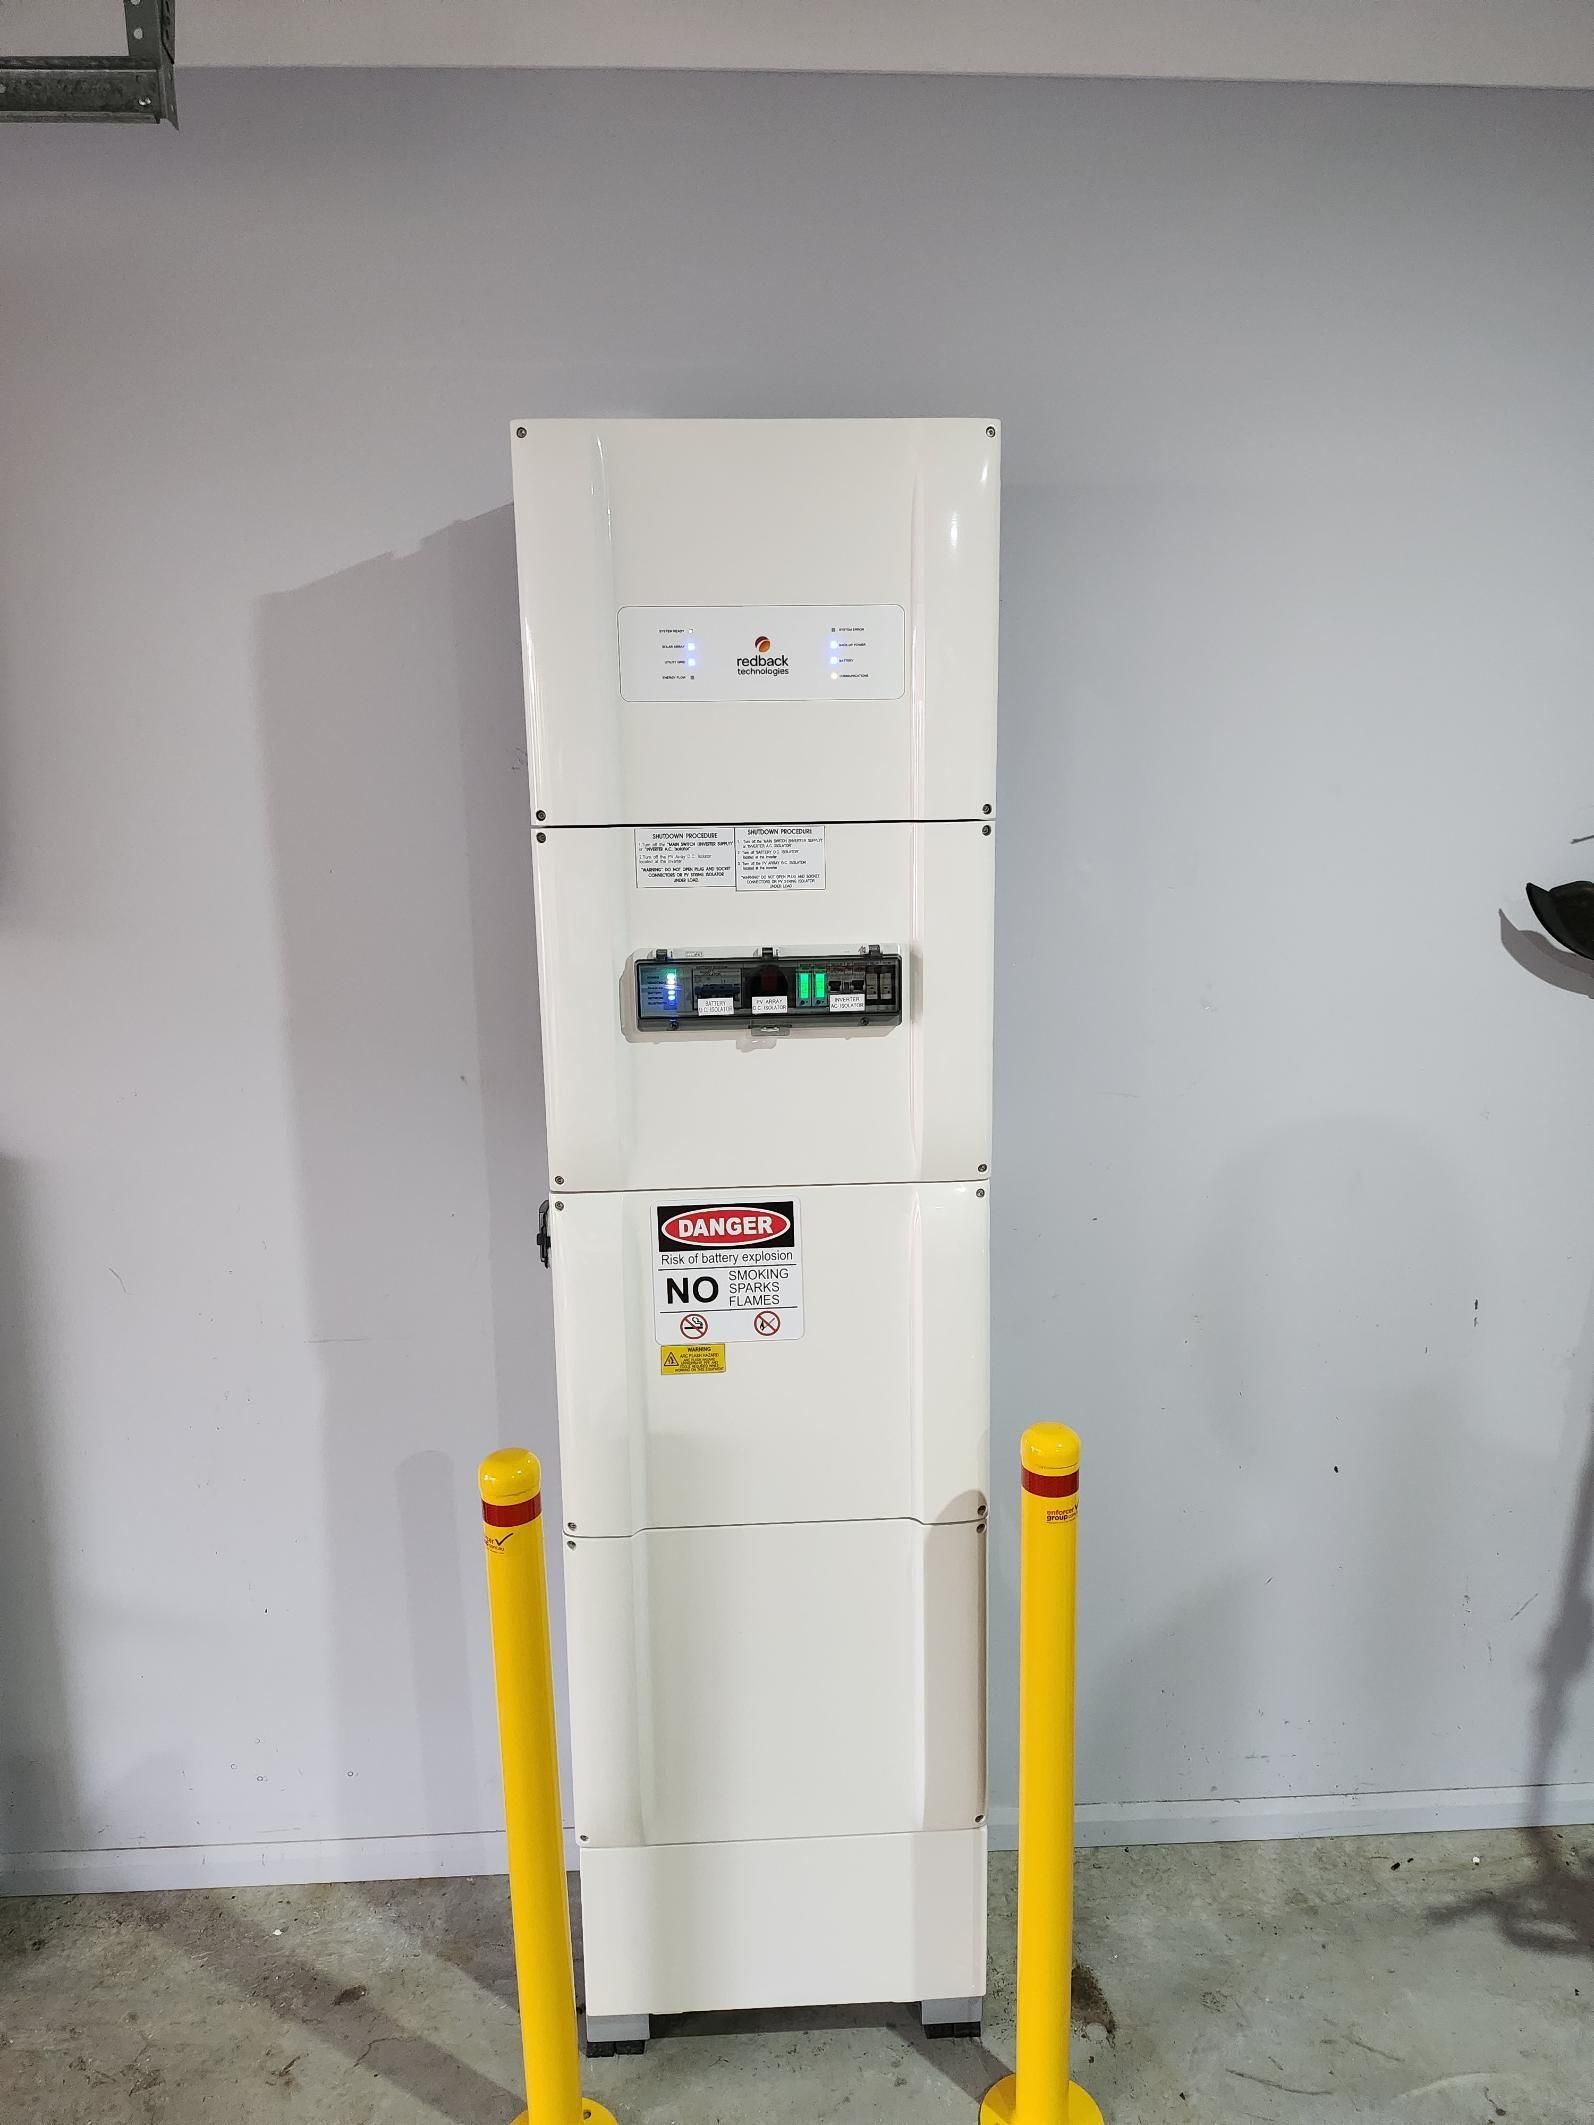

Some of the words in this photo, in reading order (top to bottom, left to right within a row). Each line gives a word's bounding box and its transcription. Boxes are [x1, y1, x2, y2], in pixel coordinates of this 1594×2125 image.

[737, 655, 788, 666] redback
[738, 667, 789, 676] technologies
[678, 1216, 773, 1237] DANGER
[661, 1254, 684, 1265] Risk
[688, 1253, 698, 1264] of
[702, 1253, 739, 1264] battery
[742, 1250, 793, 1264] explosion
[729, 1269, 789, 1280] SMOKING
[666, 1276, 719, 1304] NO
[729, 1282, 779, 1293] SPARKS
[730, 1295, 779, 1306] FLAMES
